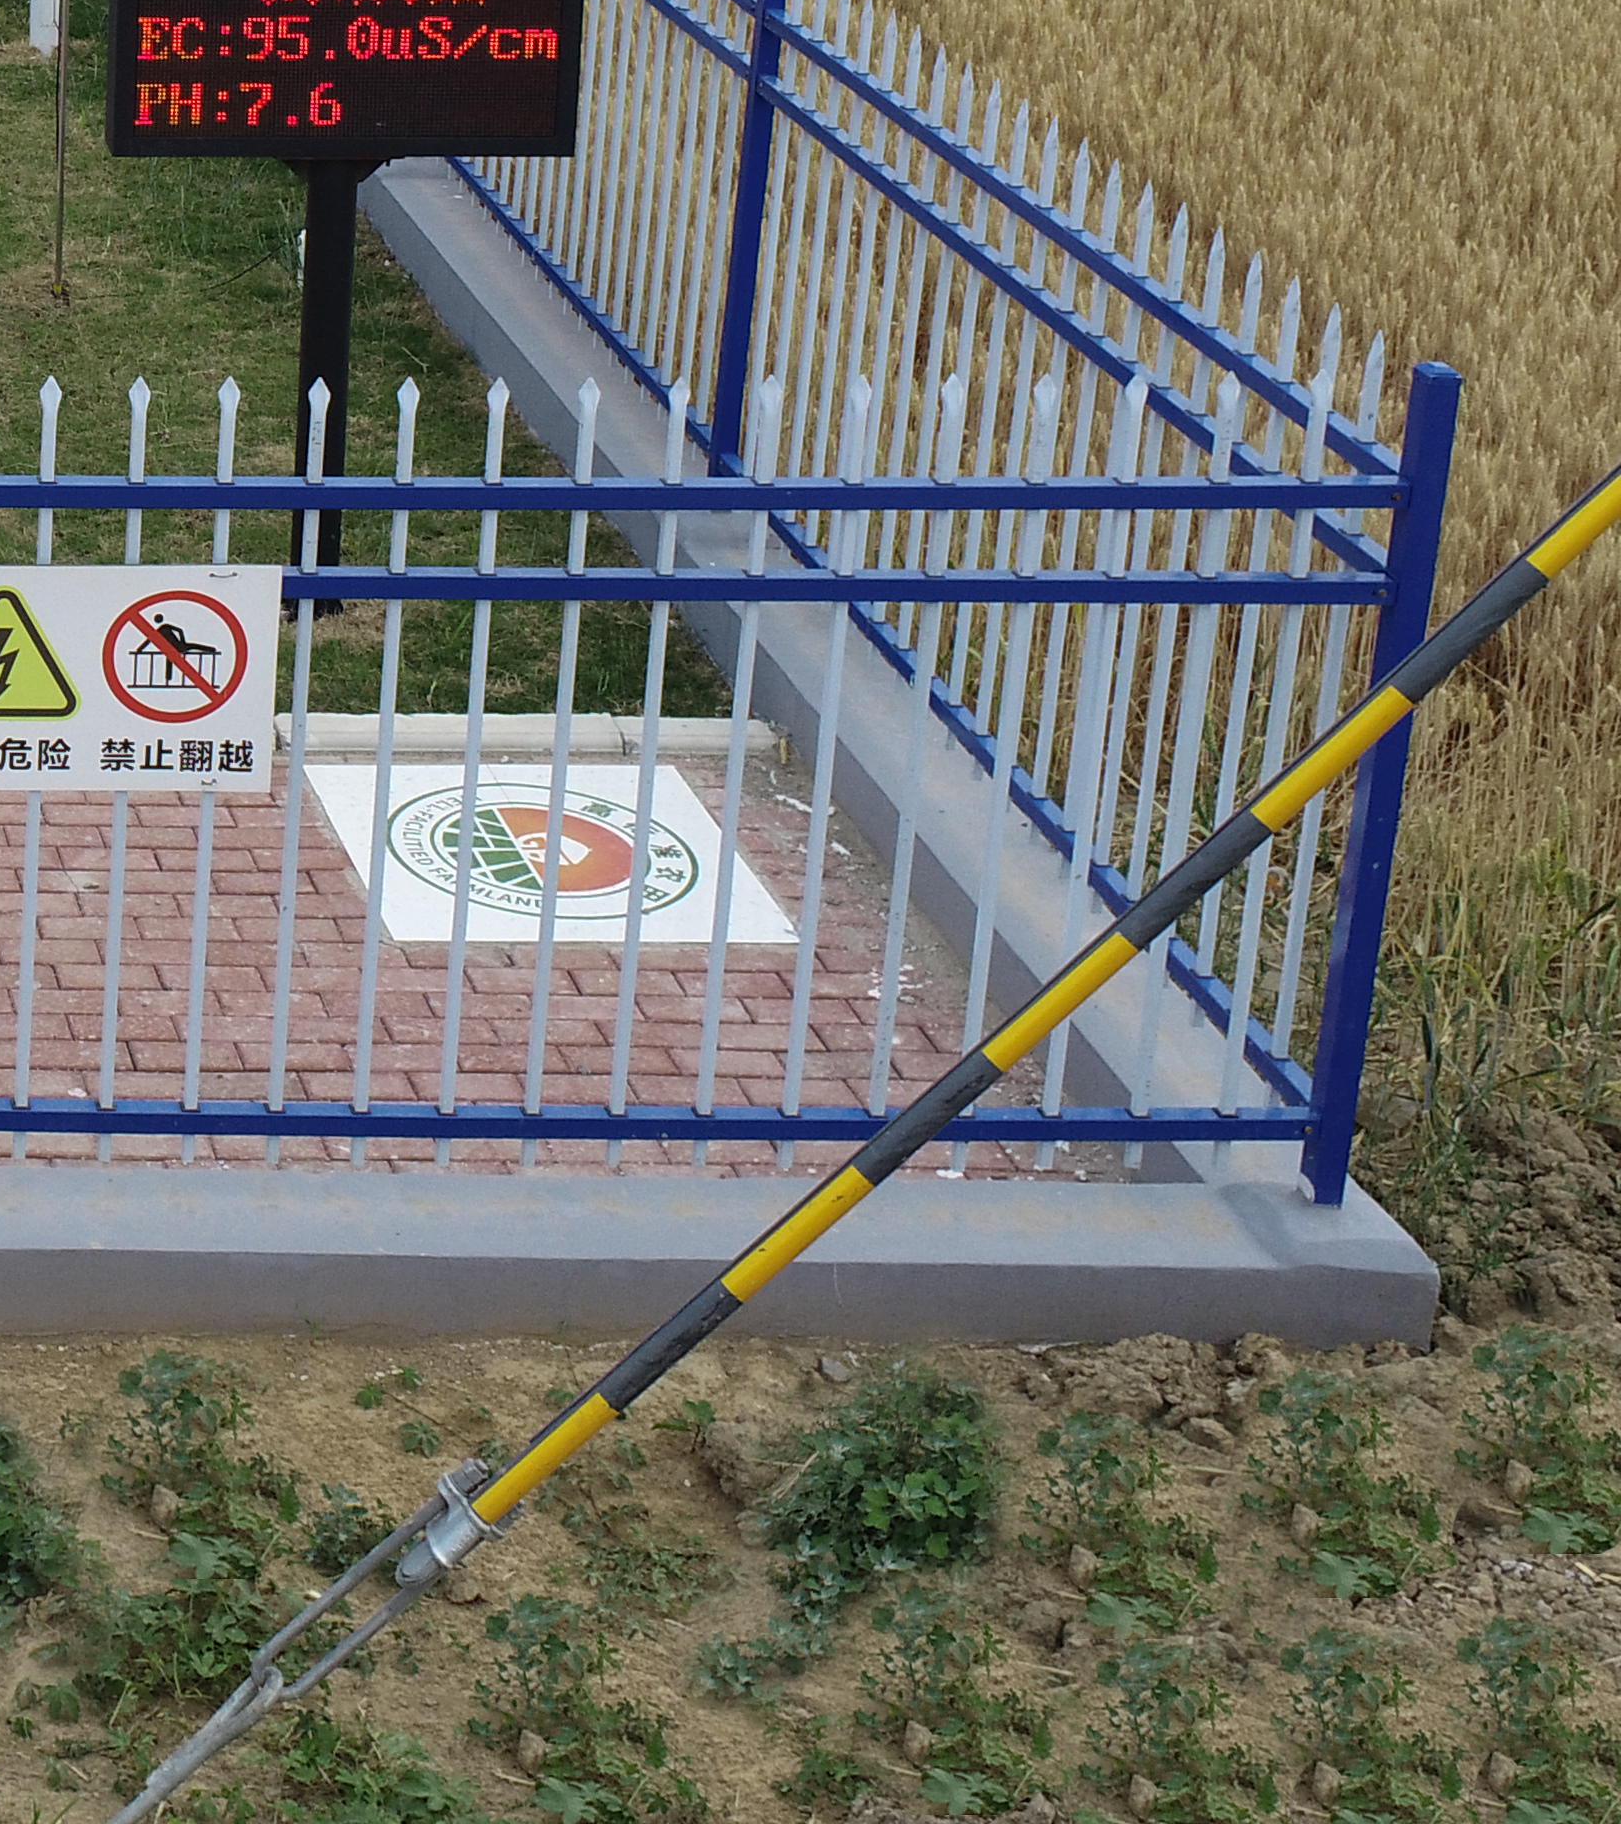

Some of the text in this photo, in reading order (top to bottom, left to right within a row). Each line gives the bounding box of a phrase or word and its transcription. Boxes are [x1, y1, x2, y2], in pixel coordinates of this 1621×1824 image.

[133, 81, 344, 127] PH:7.6
[100, 738, 254, 773] 禁止翻越
